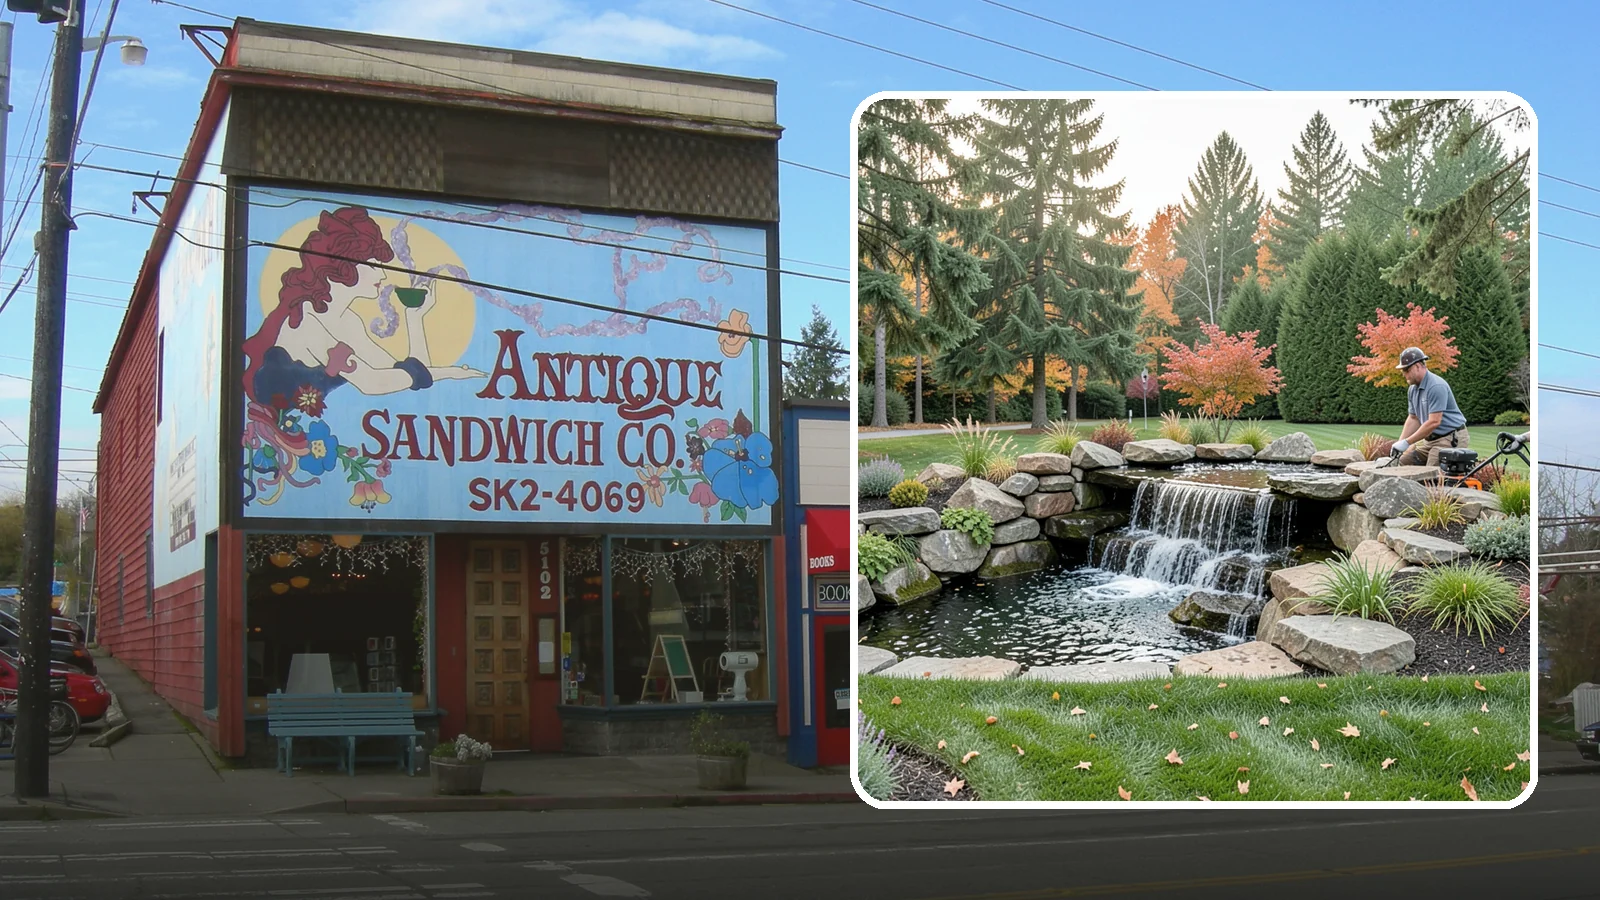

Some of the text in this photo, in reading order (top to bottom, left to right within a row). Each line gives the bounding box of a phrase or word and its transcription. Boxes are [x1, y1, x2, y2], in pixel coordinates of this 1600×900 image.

[475, 328, 724, 421] ANTIQUE
[361, 408, 685, 468] SANDWICH CO.
[468, 477, 646, 513] SK2-4069
[539, 541, 552, 600] 5102
[809, 555, 835, 569] BOOKS
